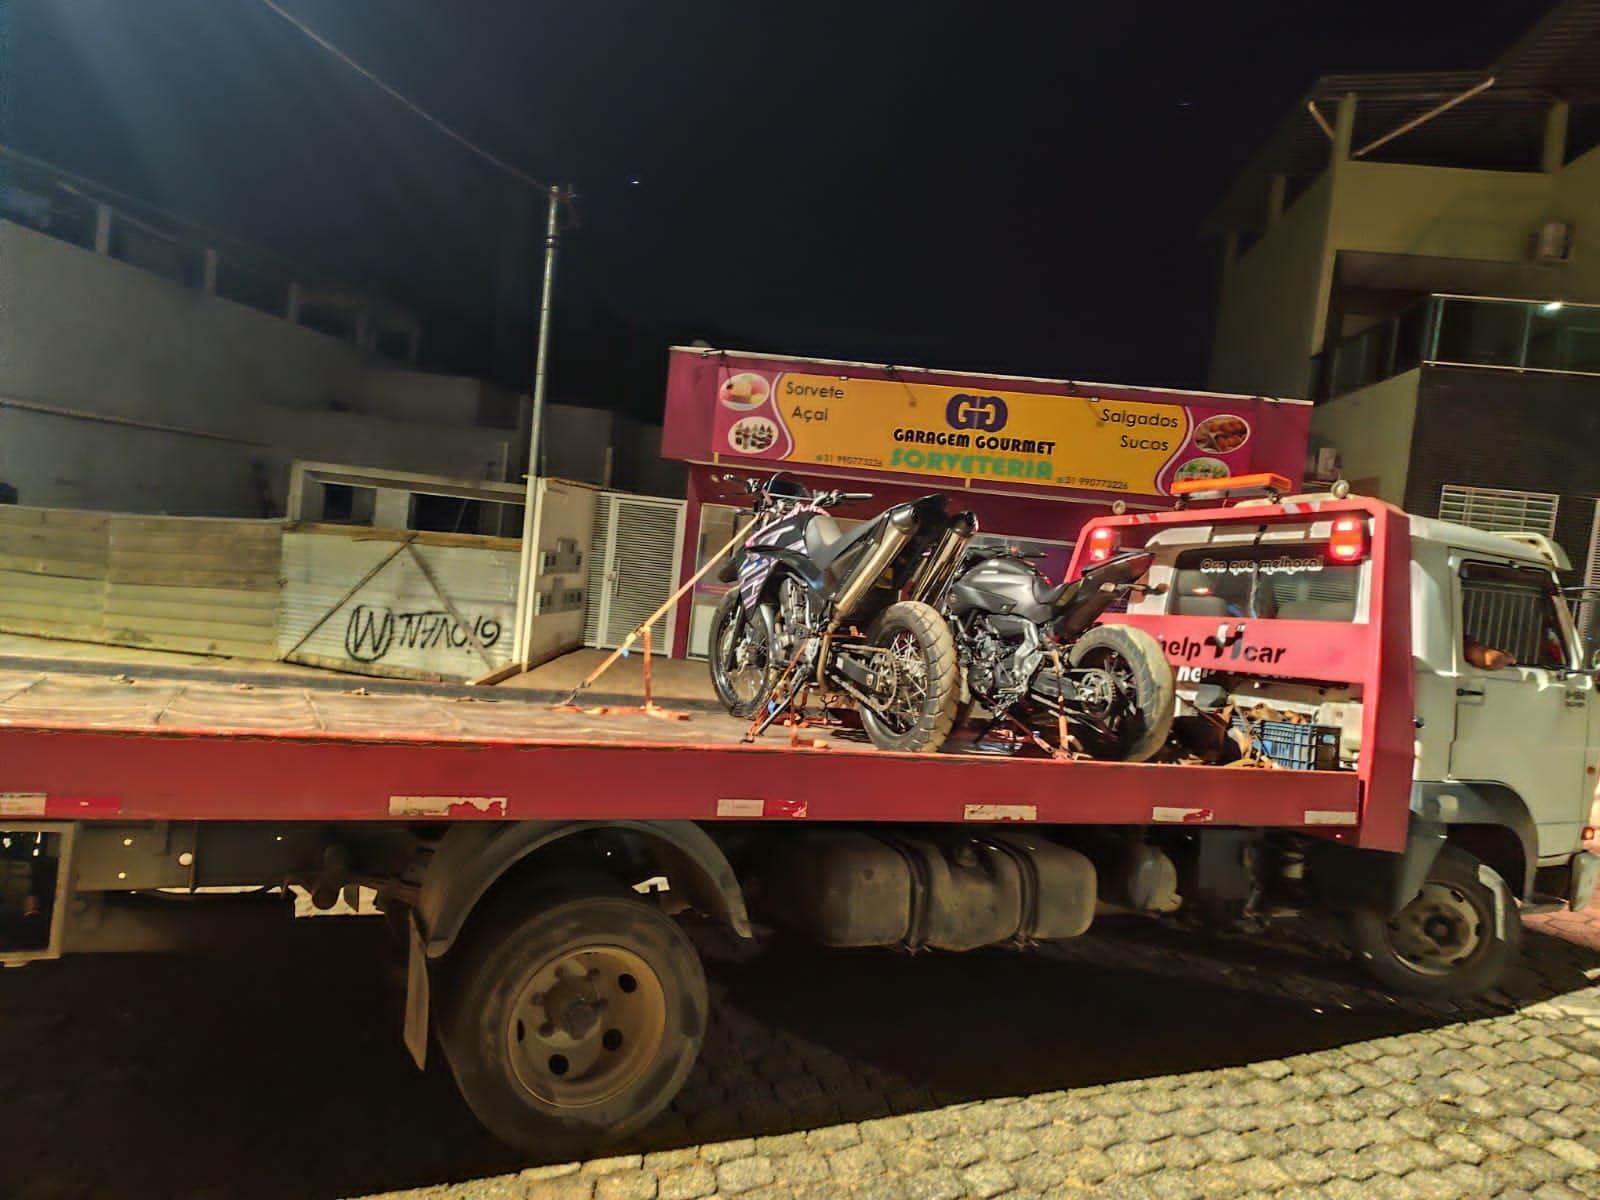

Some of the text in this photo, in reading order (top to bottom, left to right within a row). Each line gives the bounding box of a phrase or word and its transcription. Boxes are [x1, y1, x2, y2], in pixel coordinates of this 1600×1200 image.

[786, 381, 844, 399] Sorvete
[1101, 408, 1178, 428] Salgados
[893, 428, 1056, 455] GARAGEM GOURMET
[1120, 435, 1169, 451] Sucos
[891, 447, 1054, 480] SORVETERIA
[1244, 645, 1286, 664] car
